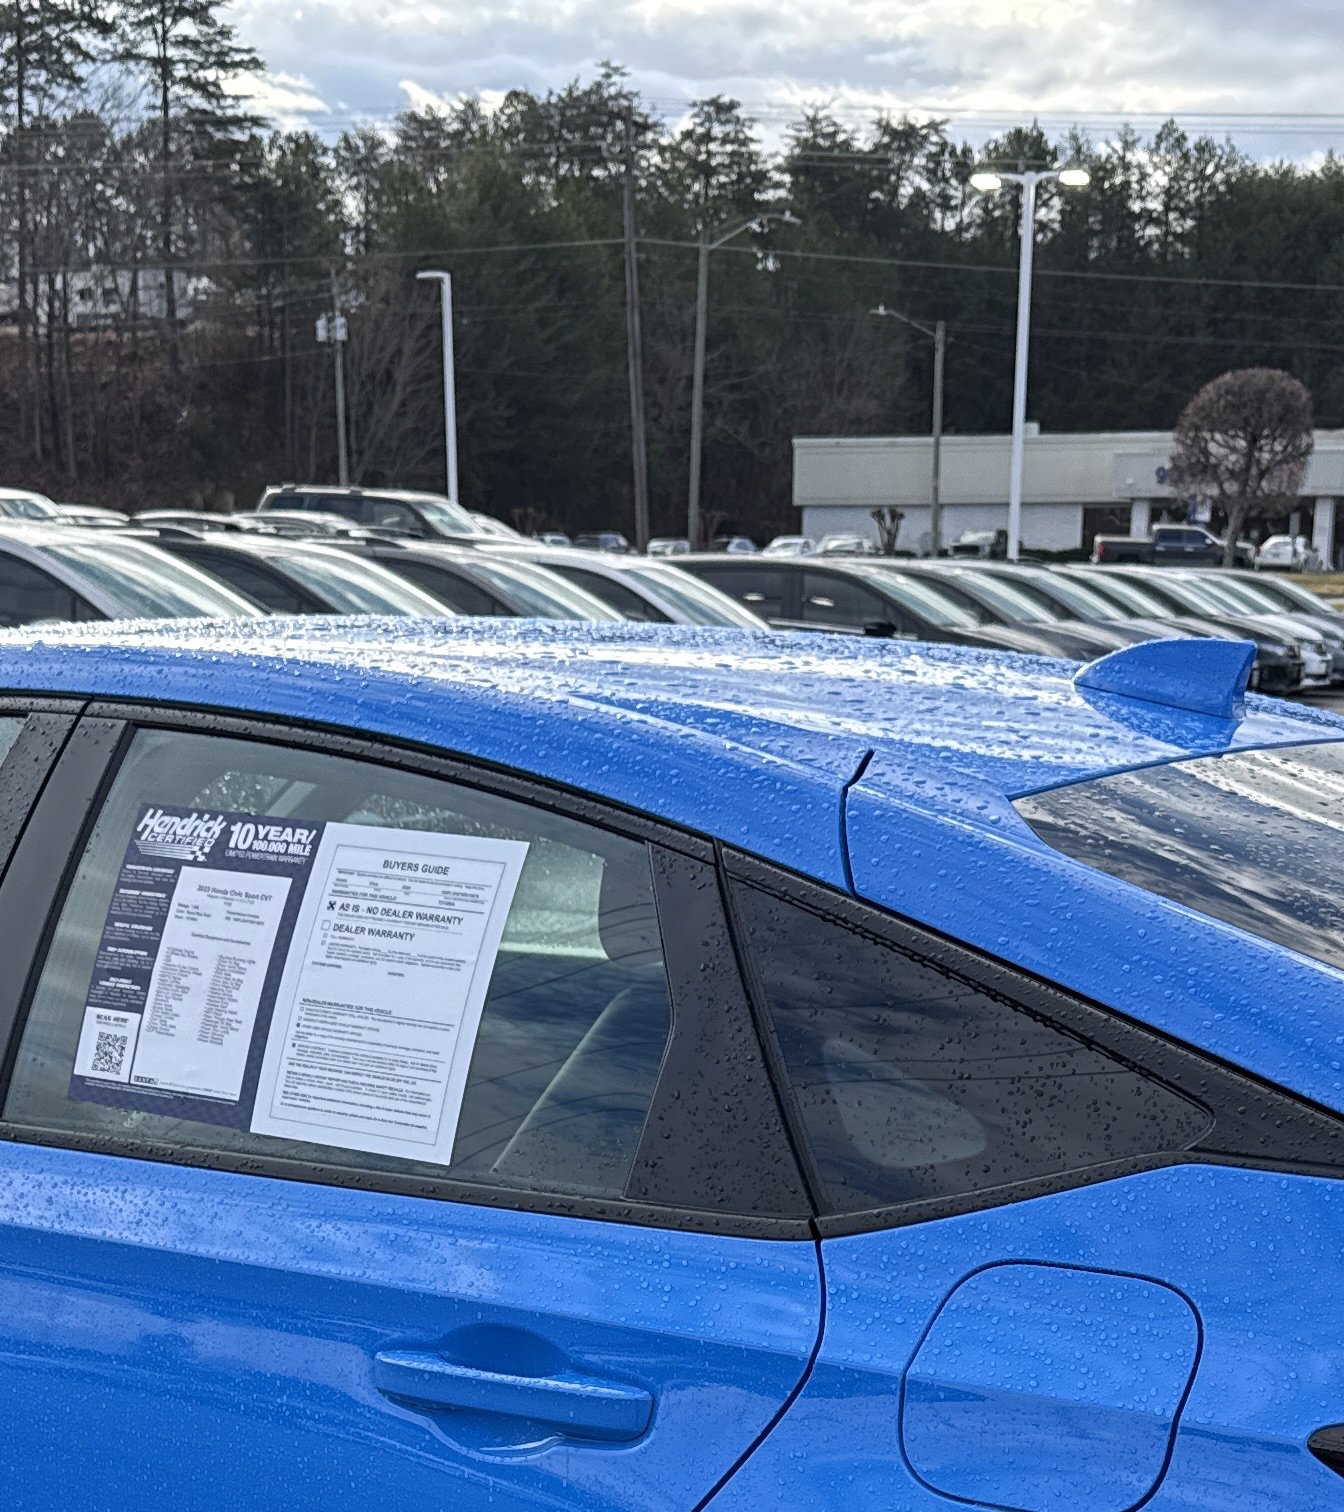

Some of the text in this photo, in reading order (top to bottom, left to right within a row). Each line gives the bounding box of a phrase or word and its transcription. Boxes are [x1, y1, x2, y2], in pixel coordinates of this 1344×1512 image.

[136, 807, 227, 841] Hendrick
[147, 832, 216, 847] CERTIFIED
[229, 821, 317, 850] 10 YEAR/
[287, 843, 313, 856] MILE
[382, 859, 451, 876] BUYERS GUIDE
[338, 902, 351, 912] AS
[351, 903, 360, 913] IS
[366, 905, 379, 916] NO
[380, 907, 414, 920] DEALER
[415, 911, 464, 926] WARRANTY
[332, 923, 367, 937] DEALER
[367, 926, 416, 942] WARRANTY
